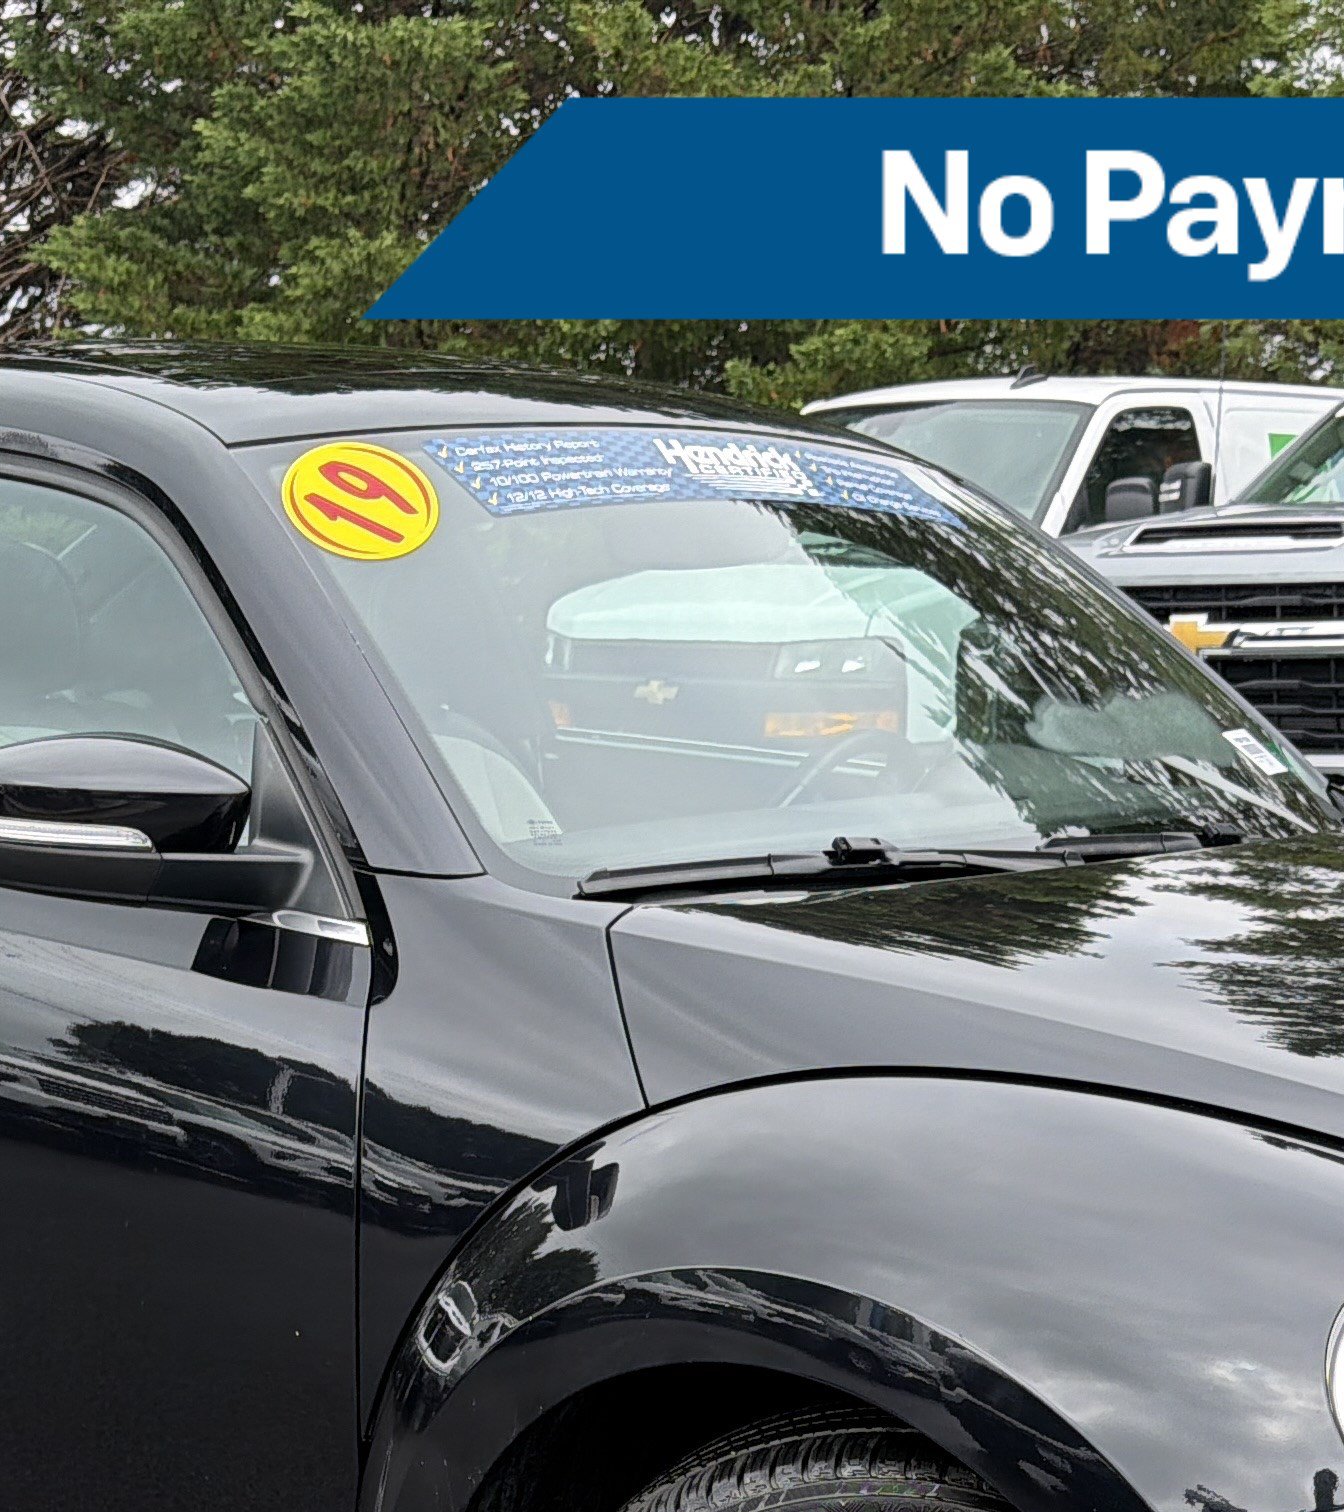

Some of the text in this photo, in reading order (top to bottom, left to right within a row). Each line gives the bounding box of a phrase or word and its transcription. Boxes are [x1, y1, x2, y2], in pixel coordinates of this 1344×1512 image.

[503, 440, 552, 455] History
[554, 438, 601, 450] Report
[652, 438, 802, 474] Hendrick
[540, 453, 604, 467] Inspected
[490, 472, 539, 487] 10/100
[303, 460, 420, 544] 19
[507, 489, 547, 504] 12/12
[610, 482, 672, 495] Coverage
